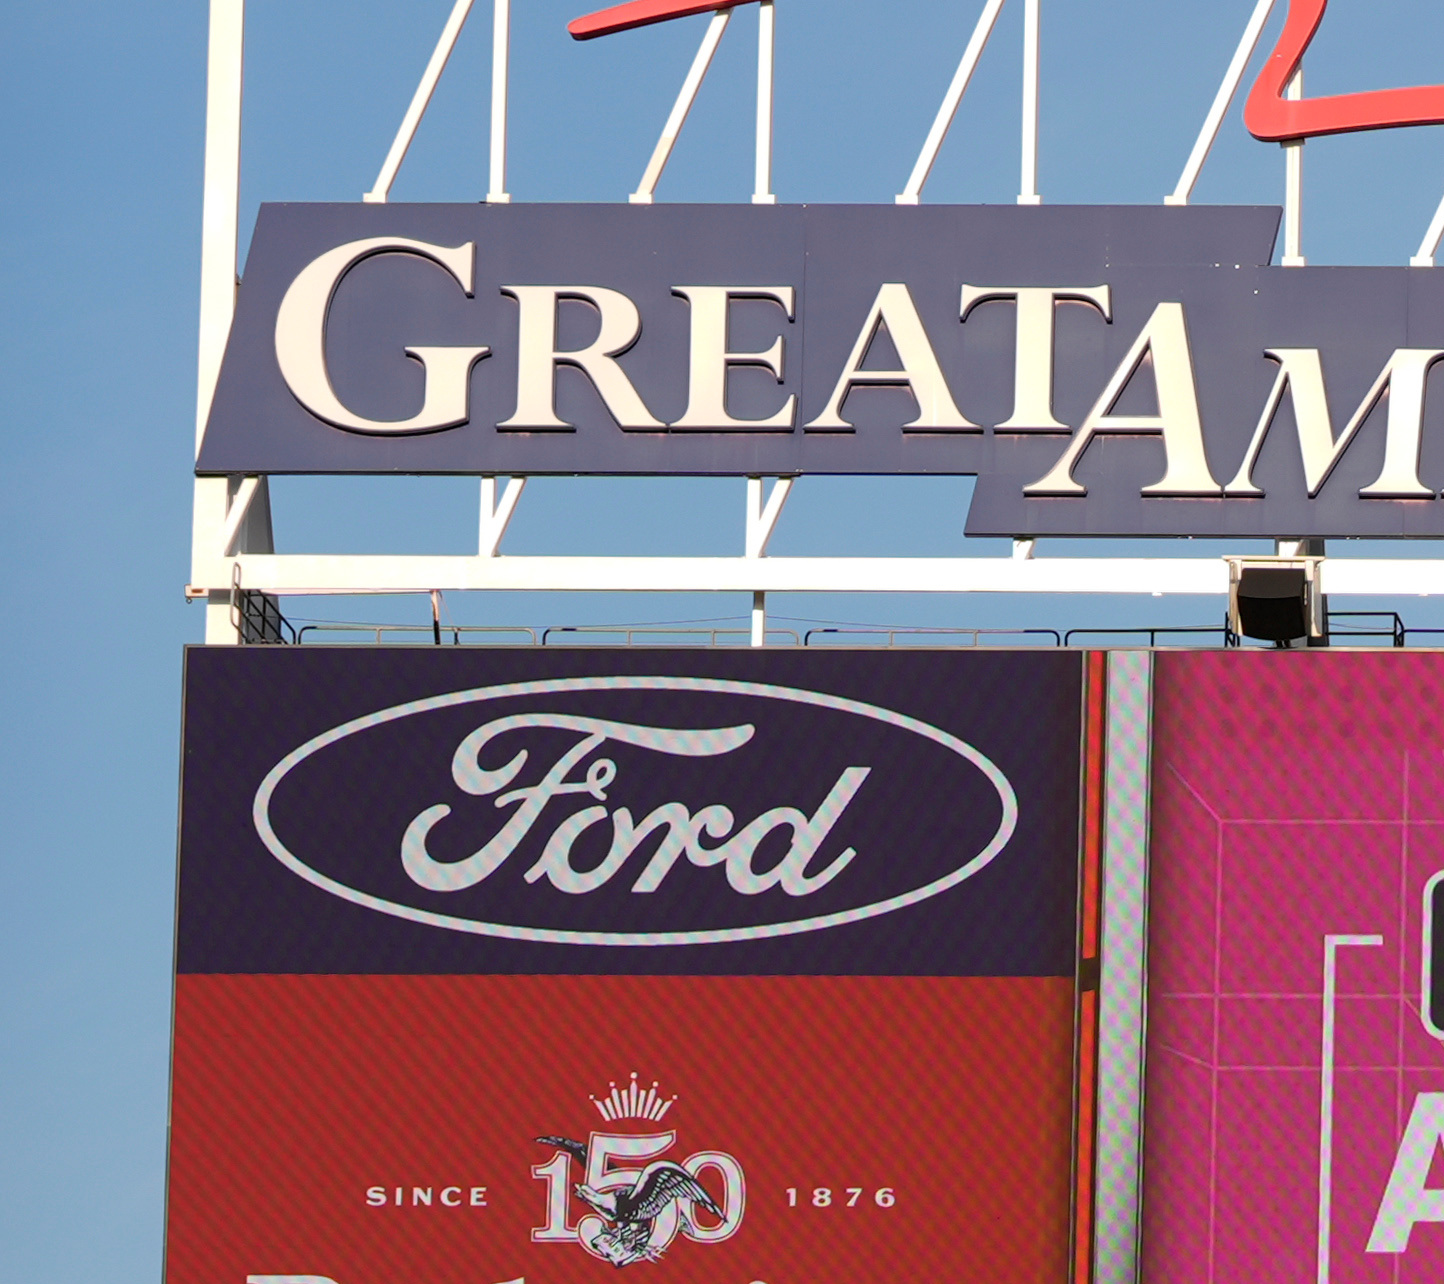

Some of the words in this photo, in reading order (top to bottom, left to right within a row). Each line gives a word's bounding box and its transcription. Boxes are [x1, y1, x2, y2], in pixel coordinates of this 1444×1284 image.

[273, 236, 1113, 435] GREAT
[401, 713, 871, 896] Ford
[366, 1186, 488, 1207] SINCE
[785, 1187, 896, 1208] 1876
